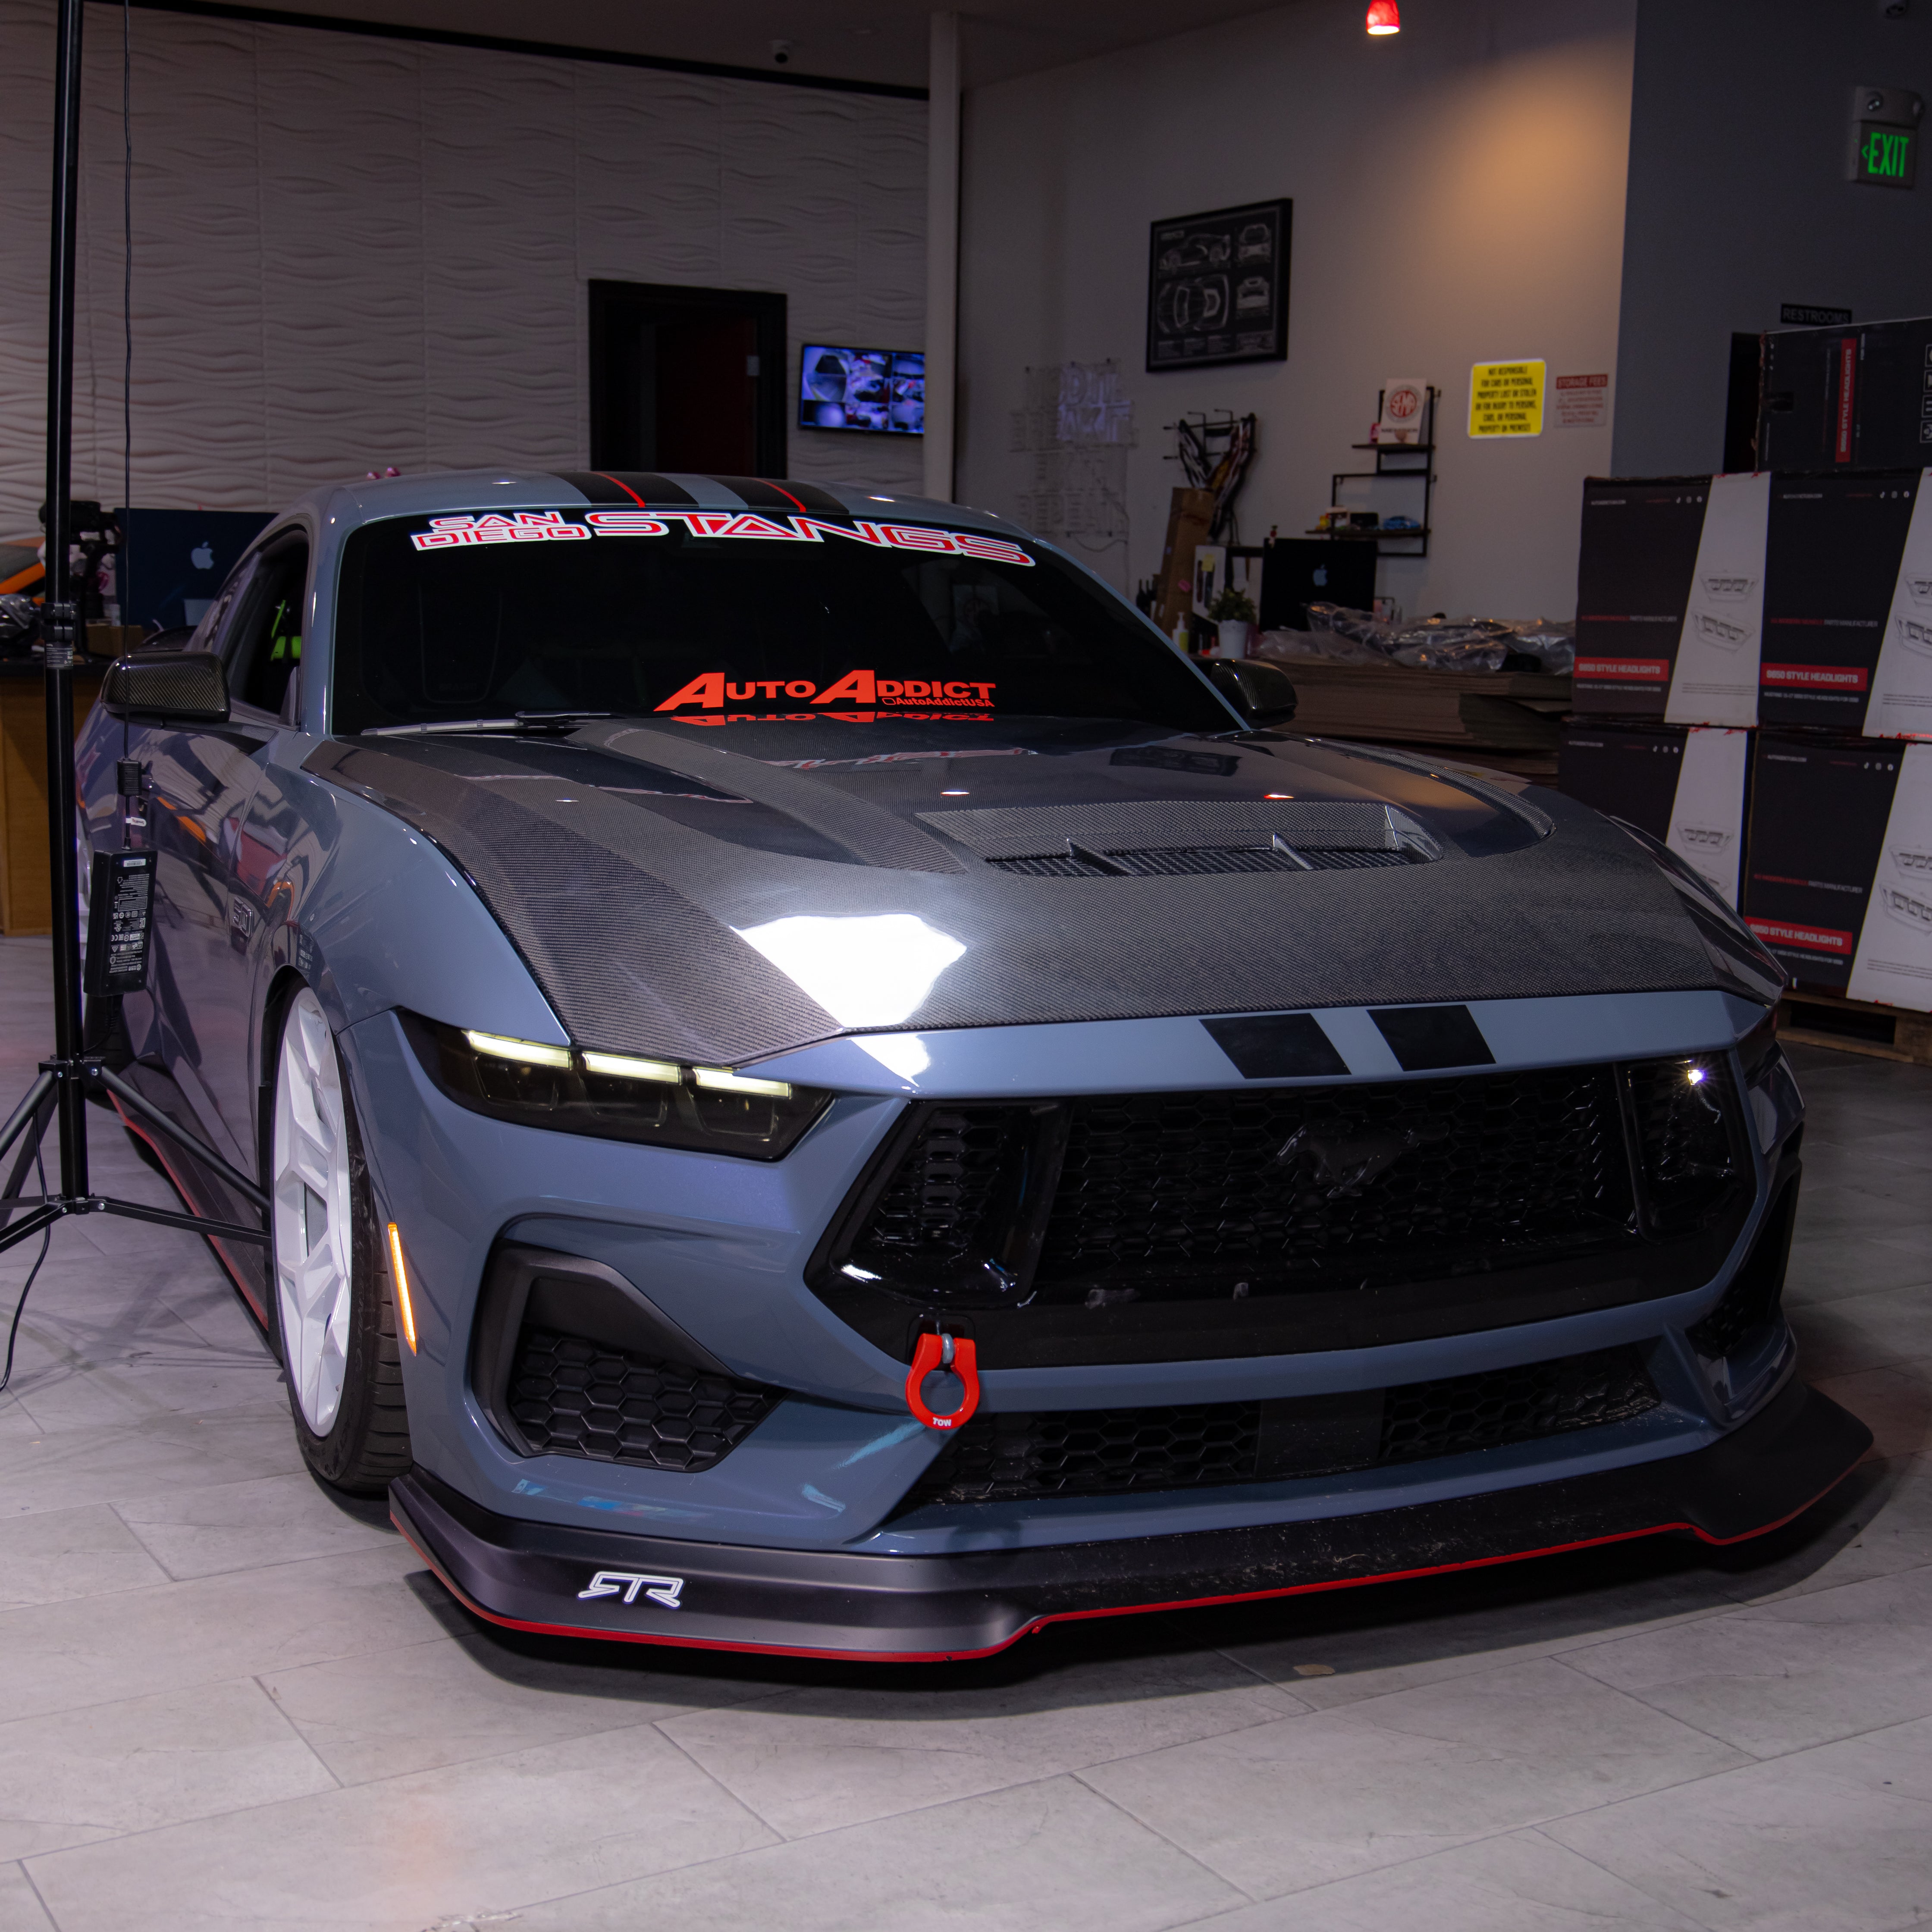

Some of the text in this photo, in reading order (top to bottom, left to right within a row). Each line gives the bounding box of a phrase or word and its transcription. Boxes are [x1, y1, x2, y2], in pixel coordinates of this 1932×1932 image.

[1868, 132, 1909, 177] EXIT
[1782, 307, 1850, 324] RESTROOMS
[1558, 376, 1607, 387] STORAGE FEES
[428, 511, 566, 532] SAN
[411, 524, 592, 551] DIEGO
[585, 511, 1036, 567] STANGS
[1596, 664, 1617, 673] STYLE
[1618, 665, 1660, 674] HEADLIGHTS
[1786, 671, 1809, 681] STYLE
[1810, 672, 1858, 684] HEADLIGHTS
[653, 670, 996, 712] AUTO ADDICT
[1769, 927, 1793, 939] STYLE
[1794, 930, 1843, 946] HEADLIGHTS
[933, 1417, 952, 1427] TOW
